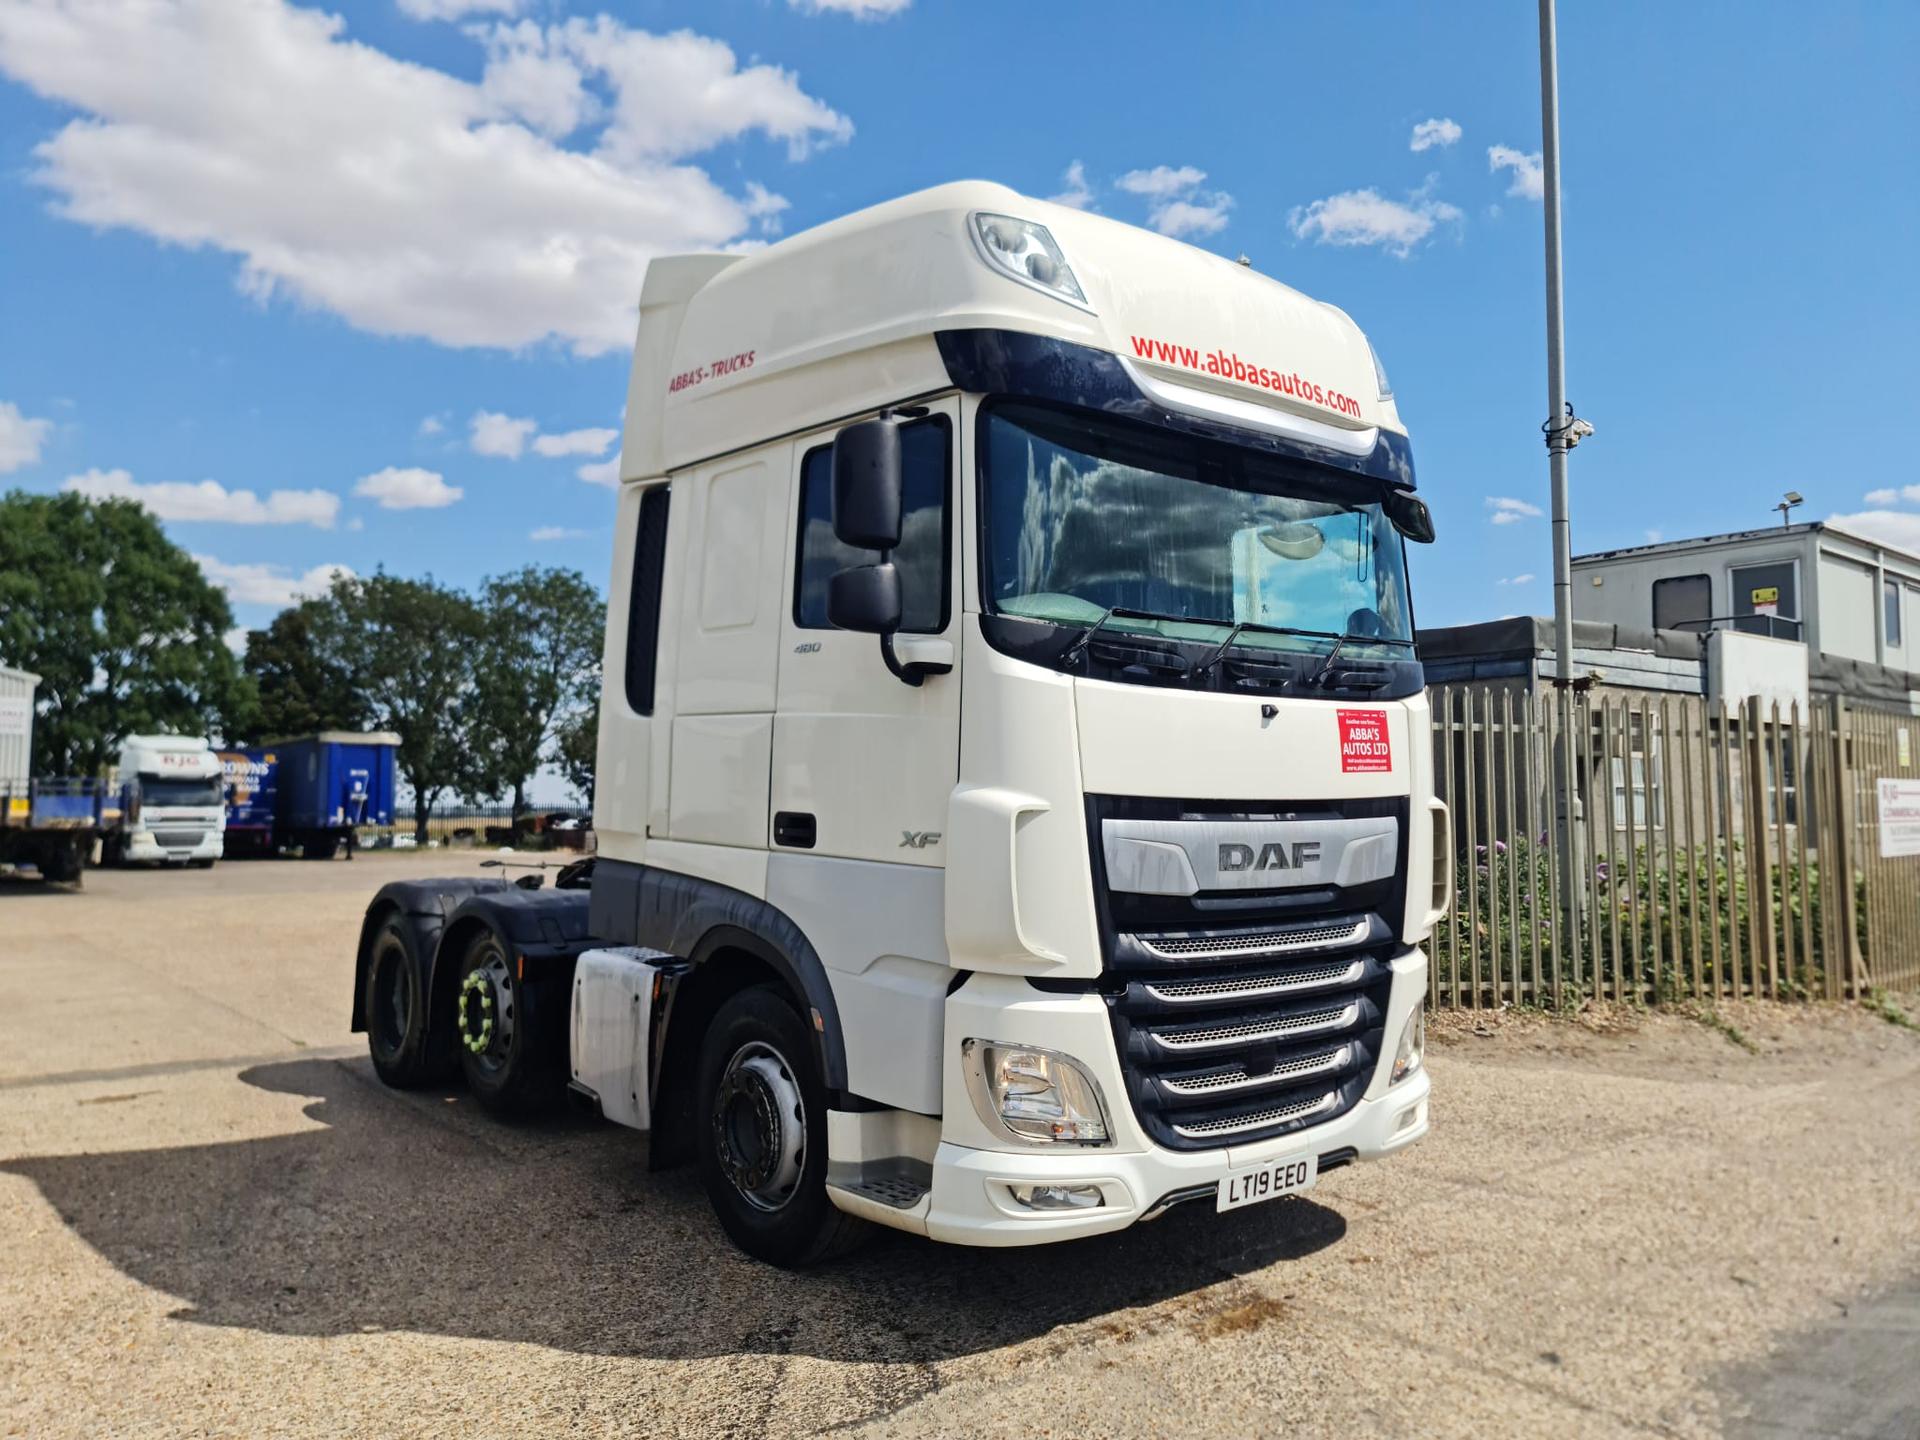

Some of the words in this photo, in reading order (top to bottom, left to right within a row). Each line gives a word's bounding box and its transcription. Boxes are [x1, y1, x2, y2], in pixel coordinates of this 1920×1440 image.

[1131, 336, 1361, 418] www.abbasautos.com
[1350, 728, 1380, 741] ABBA'S
[1343, 742, 1372, 756] AUTOS
[1373, 743, 1388, 756] LTD
[899, 831, 942, 849] XF
[1219, 842, 1321, 872] DAF
[1229, 1171, 1270, 1203] LT19
[1274, 1161, 1307, 1191] EEO
